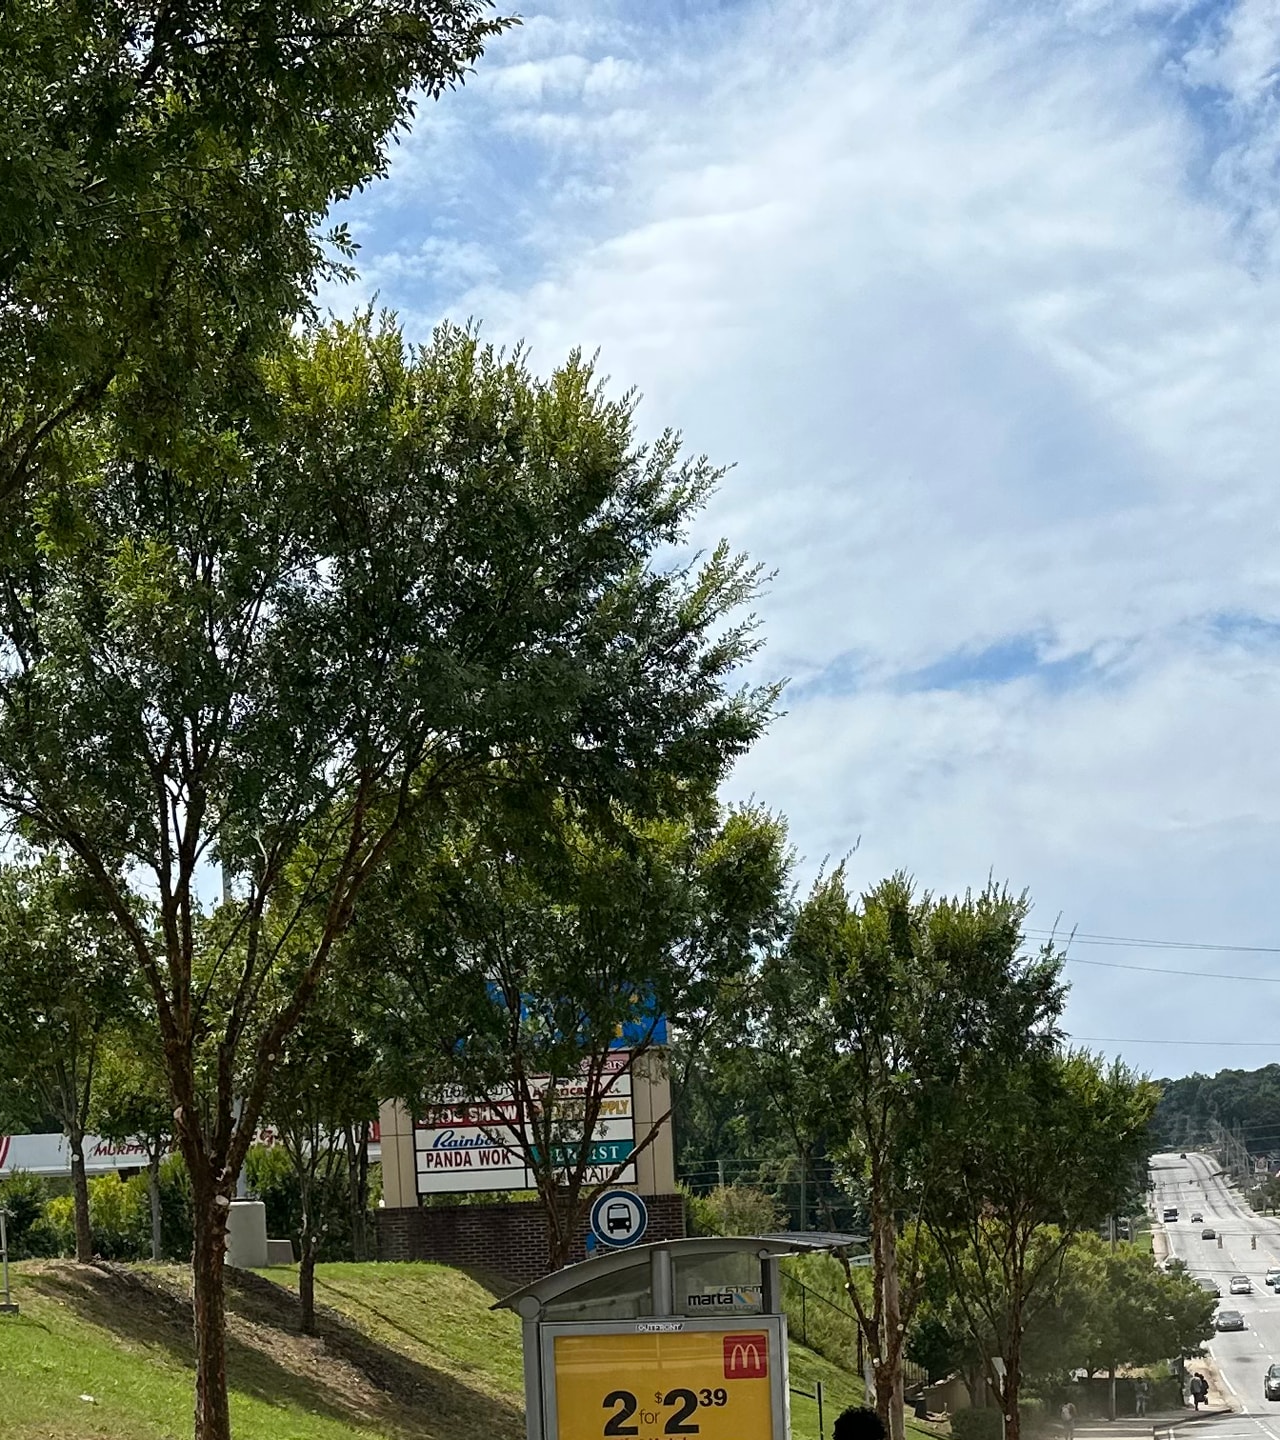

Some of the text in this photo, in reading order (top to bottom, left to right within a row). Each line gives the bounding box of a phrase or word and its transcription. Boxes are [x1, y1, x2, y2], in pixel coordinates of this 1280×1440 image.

[426, 1149, 512, 1169] PANDA WOK
[688, 1294, 733, 1306] marta
[603, 1391, 638, 1436] 2
[639, 1410, 660, 1424] for
